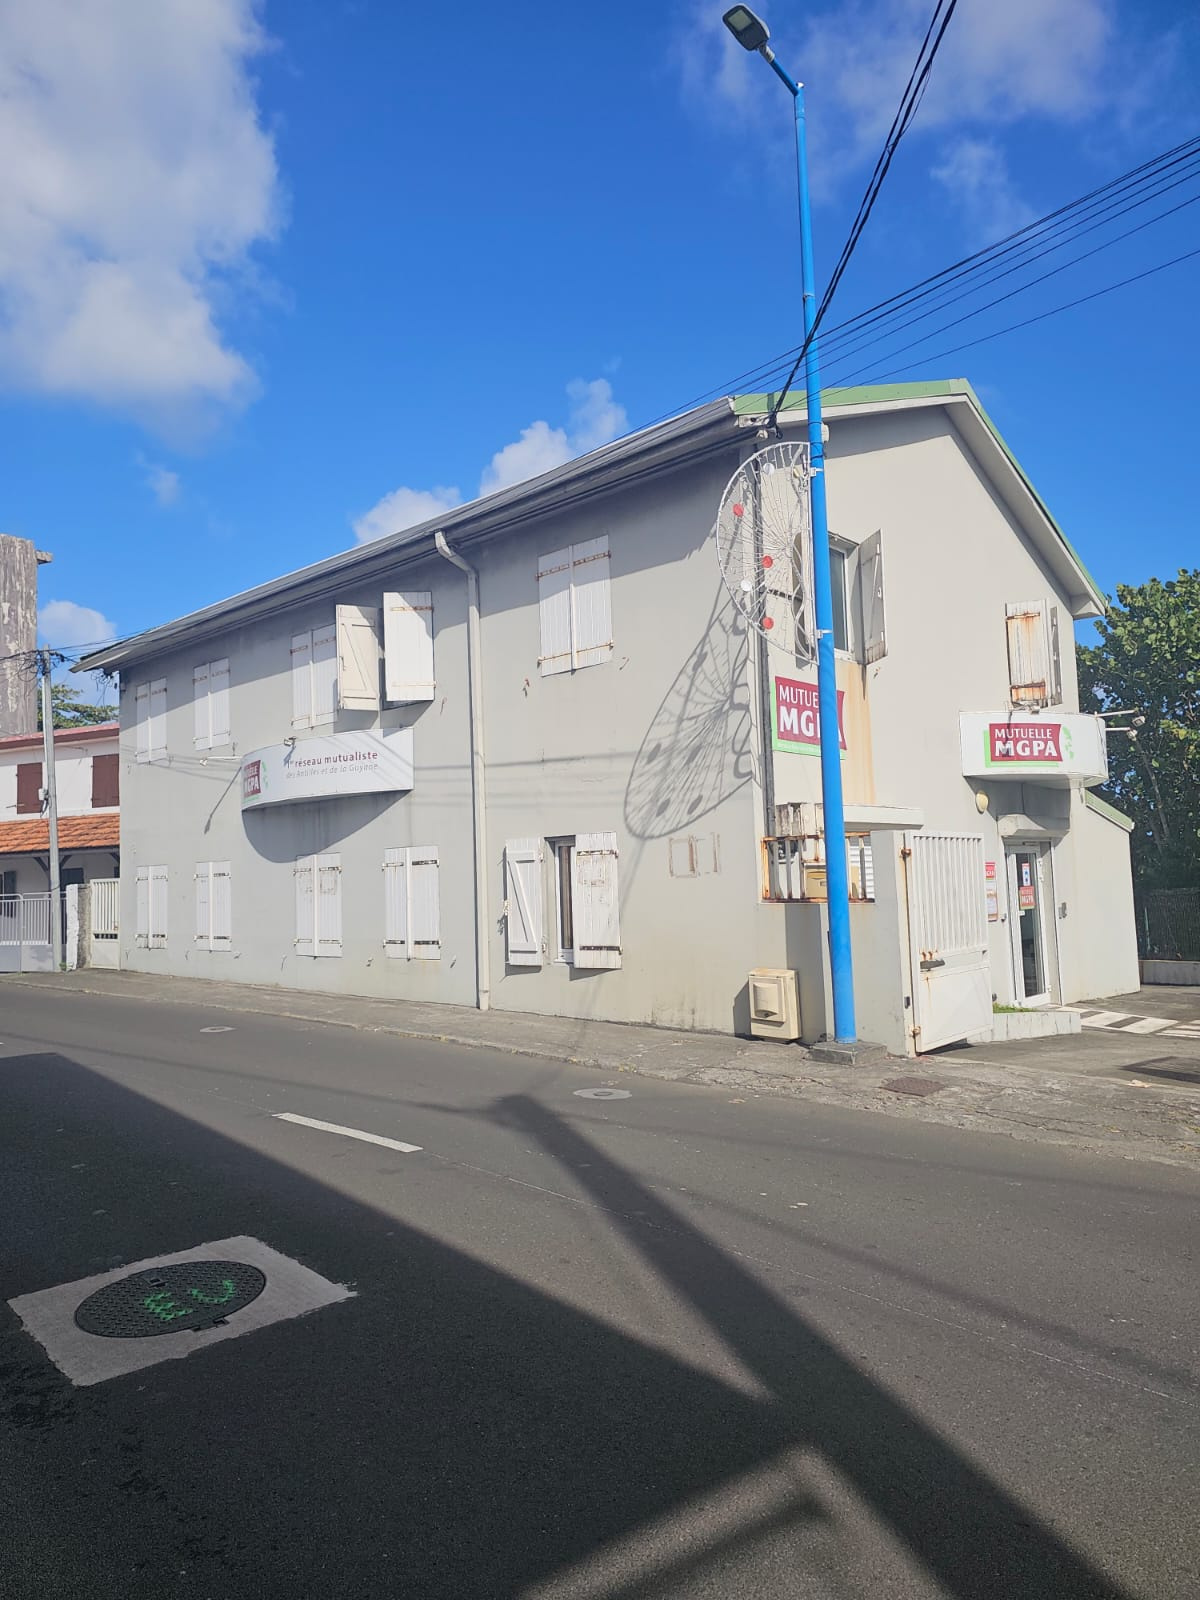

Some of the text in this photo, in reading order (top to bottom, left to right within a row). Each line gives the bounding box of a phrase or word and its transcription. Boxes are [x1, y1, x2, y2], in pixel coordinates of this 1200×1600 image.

[779, 684, 819, 708] MUTUE
[780, 706, 842, 742] MG
[994, 728, 1052, 739] MUTUELLE
[994, 740, 1058, 757] MGPA
[295, 757, 322, 768] réseau
[324, 751, 378, 764] mutualiste
